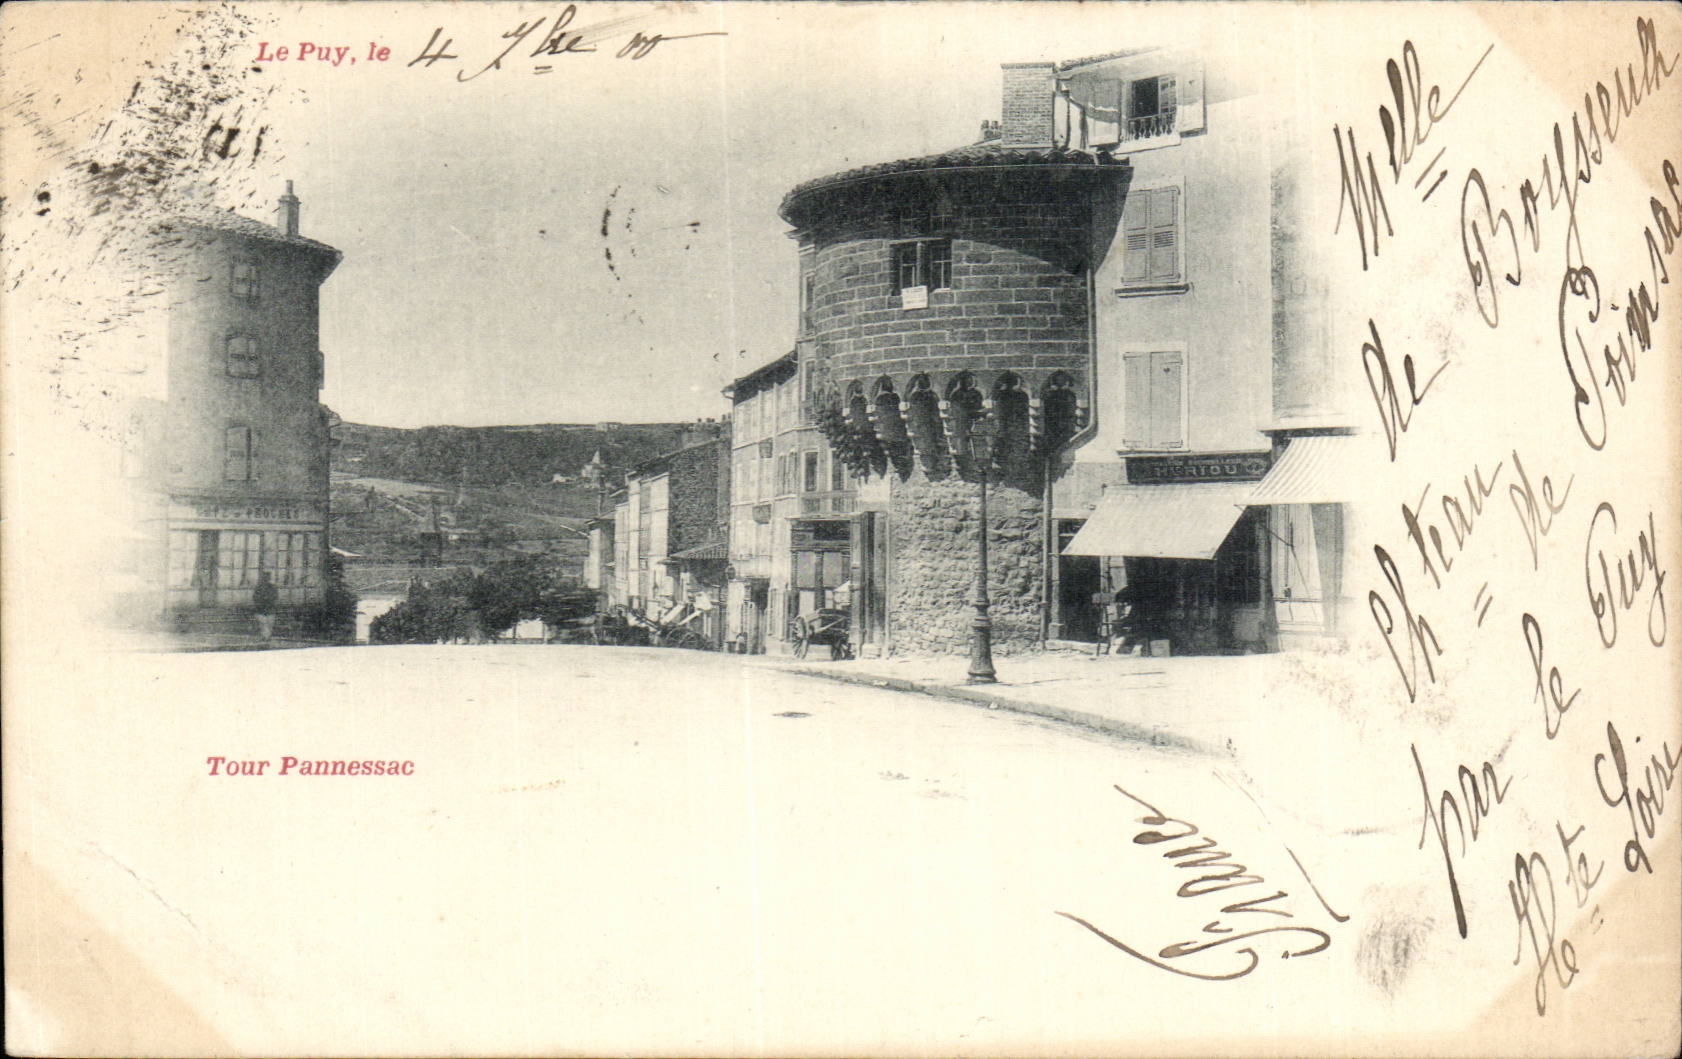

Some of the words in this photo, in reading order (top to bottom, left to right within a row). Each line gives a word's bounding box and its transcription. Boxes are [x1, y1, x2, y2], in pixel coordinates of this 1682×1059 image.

[407, 26, 458, 68] 4
[1362, 318, 1451, 463] de
[1509, 448, 1575, 572] de
[1411, 742, 1514, 939] par
[1522, 612, 1582, 740] le
[1584, 501, 1667, 648] Puy
